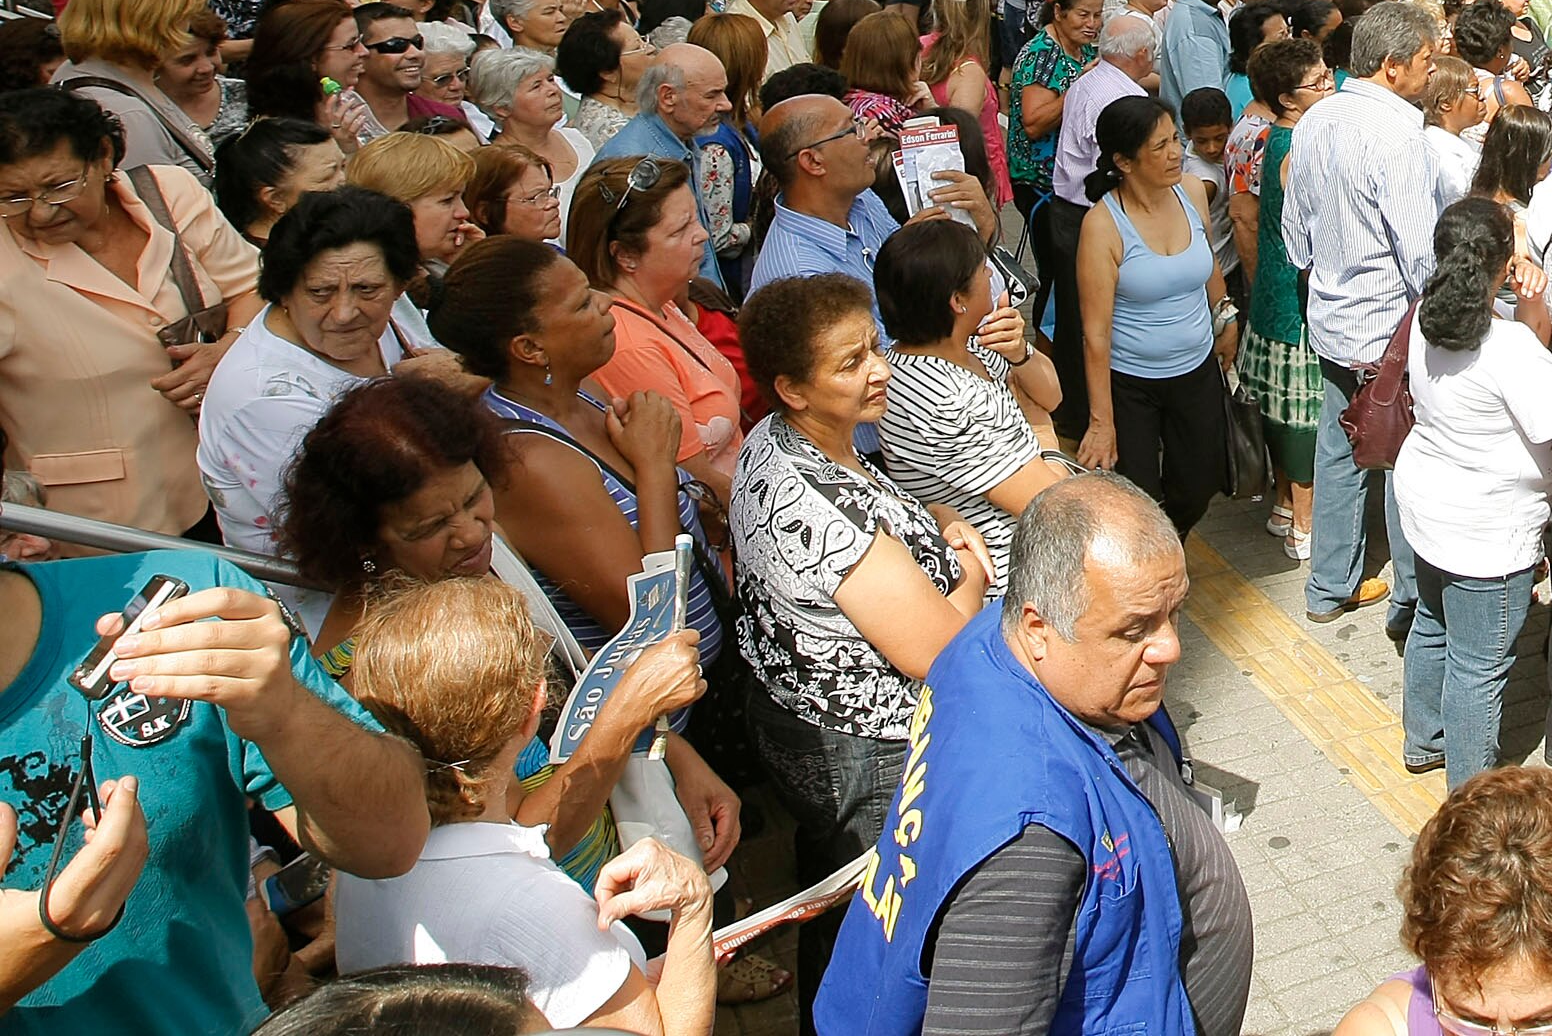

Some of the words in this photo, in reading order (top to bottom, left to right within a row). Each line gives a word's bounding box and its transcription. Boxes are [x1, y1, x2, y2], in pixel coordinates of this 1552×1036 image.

[901, 133, 925, 145] Edson
[925, 128, 956, 142] Ferrarini
[567, 686, 604, 742] São
